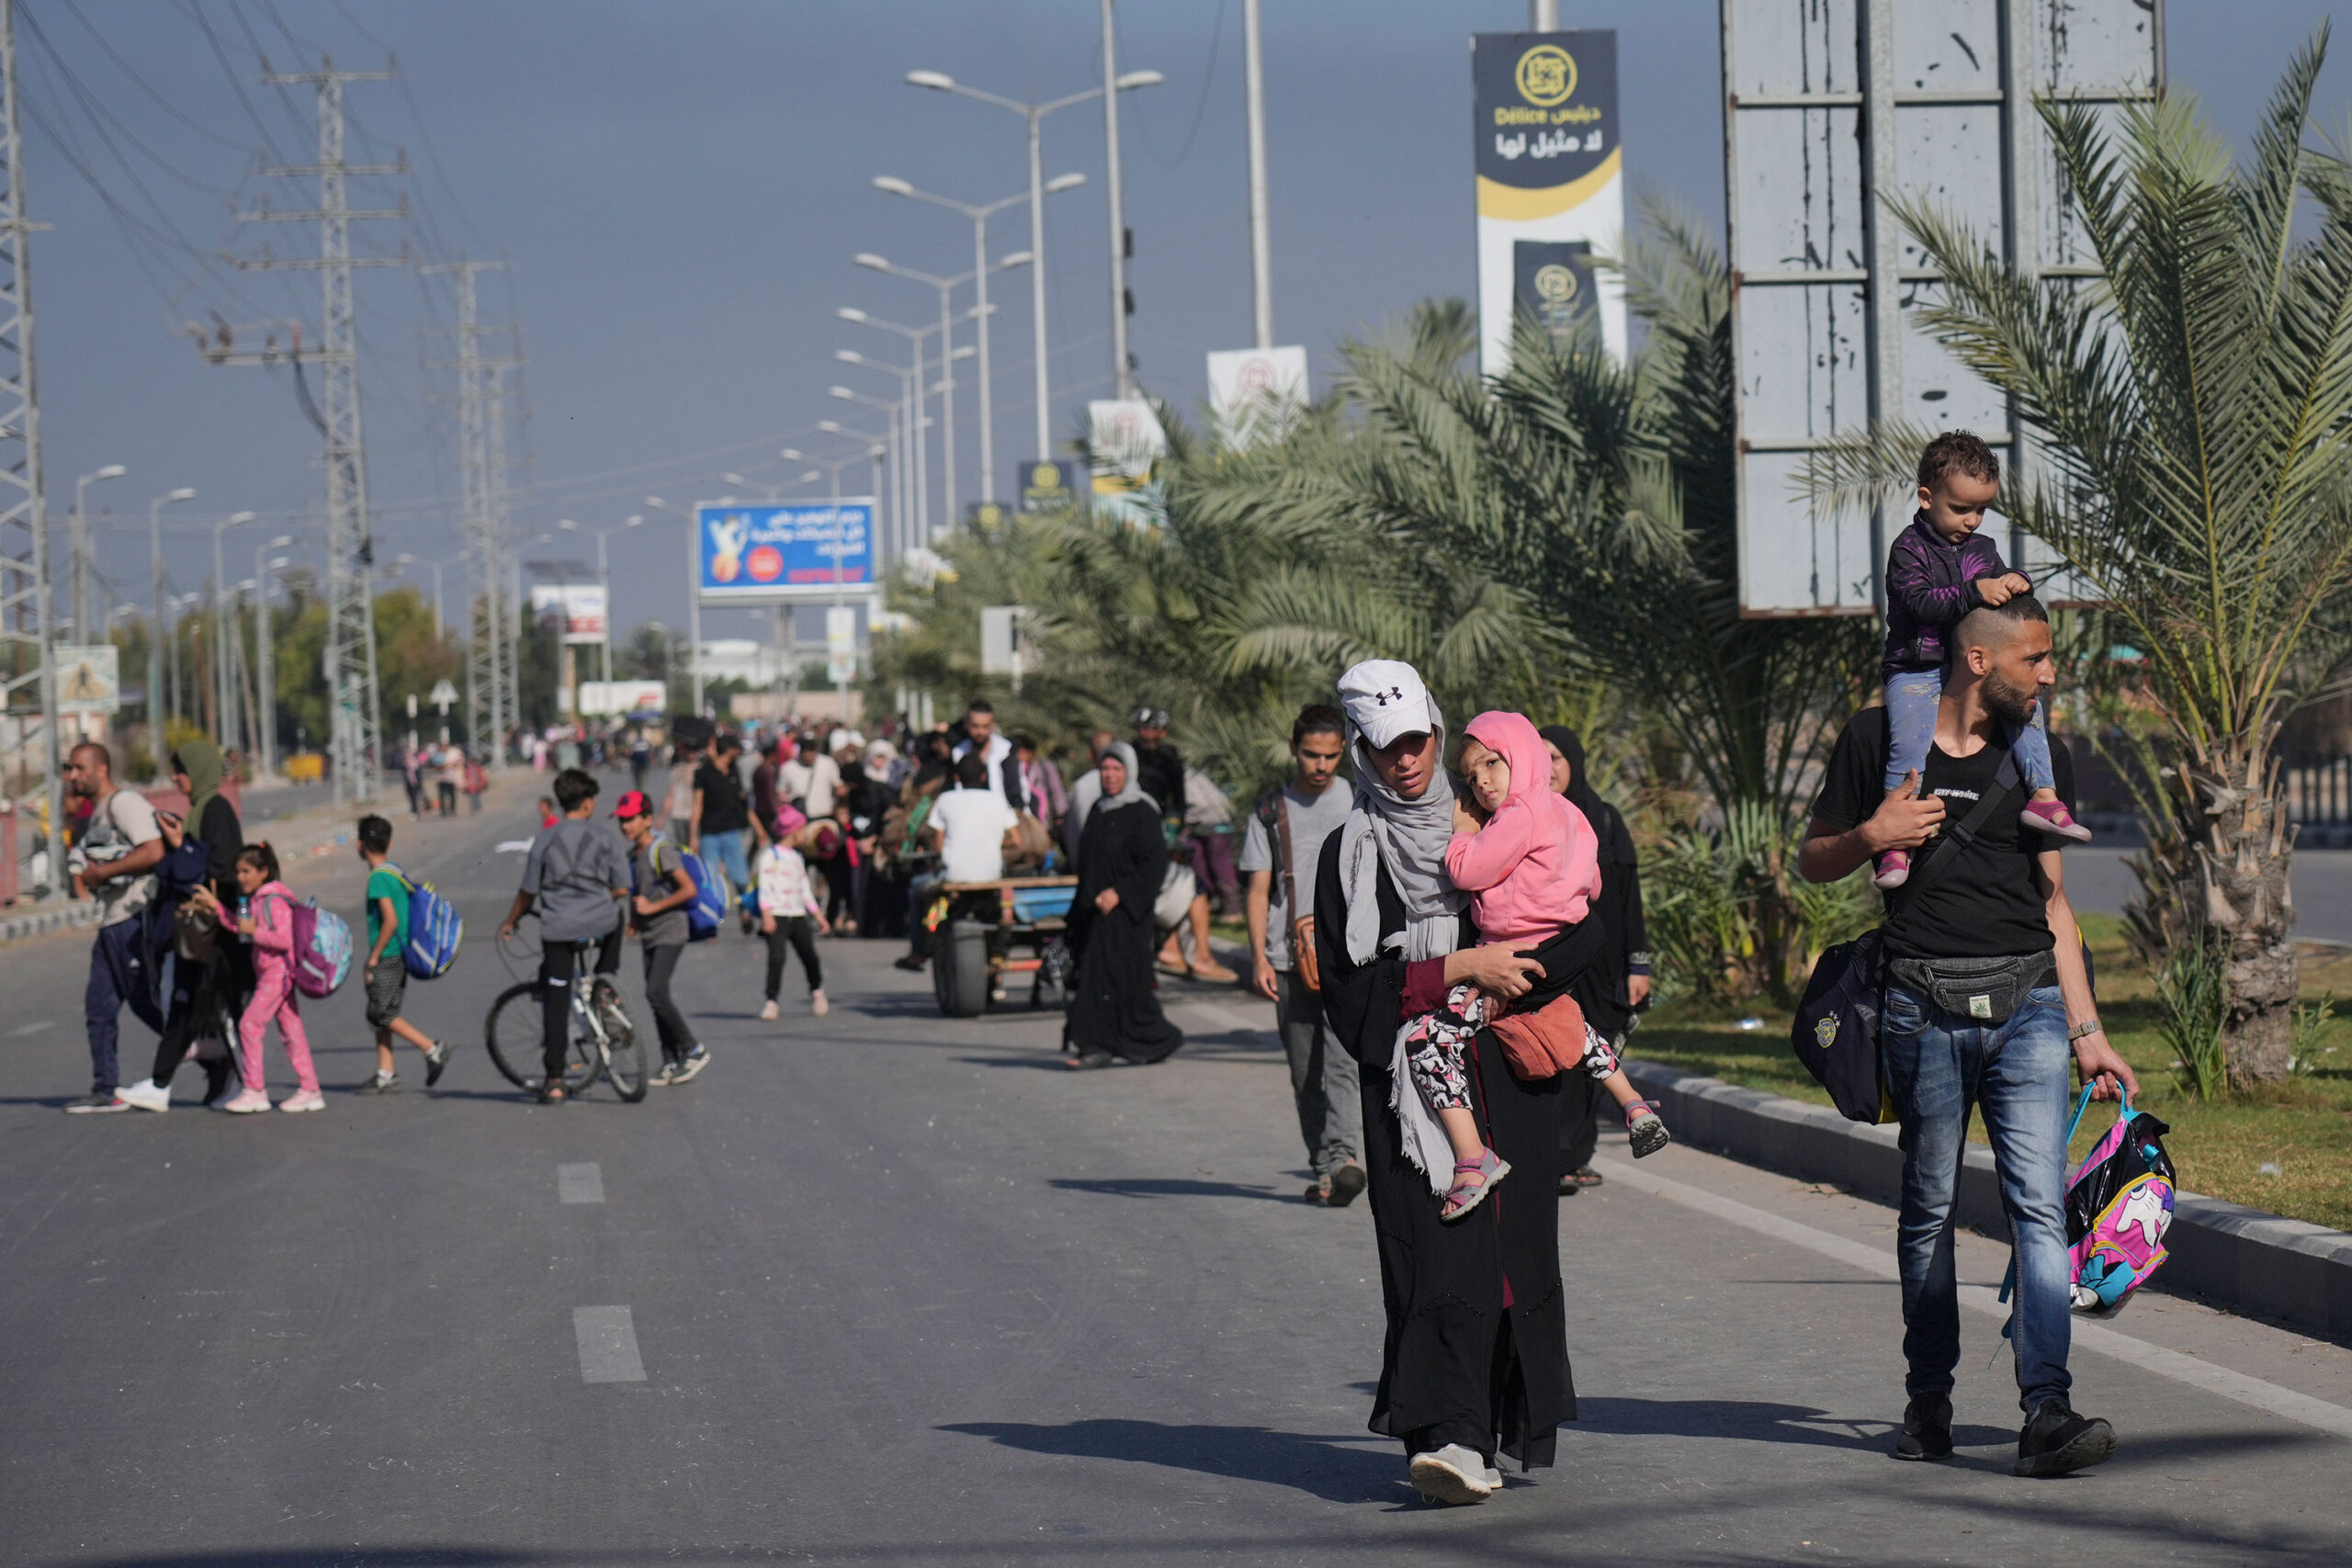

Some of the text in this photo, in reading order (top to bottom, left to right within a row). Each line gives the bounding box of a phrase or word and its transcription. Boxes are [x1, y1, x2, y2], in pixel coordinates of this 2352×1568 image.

[1495, 129, 1603, 160] لا مثيل لها
